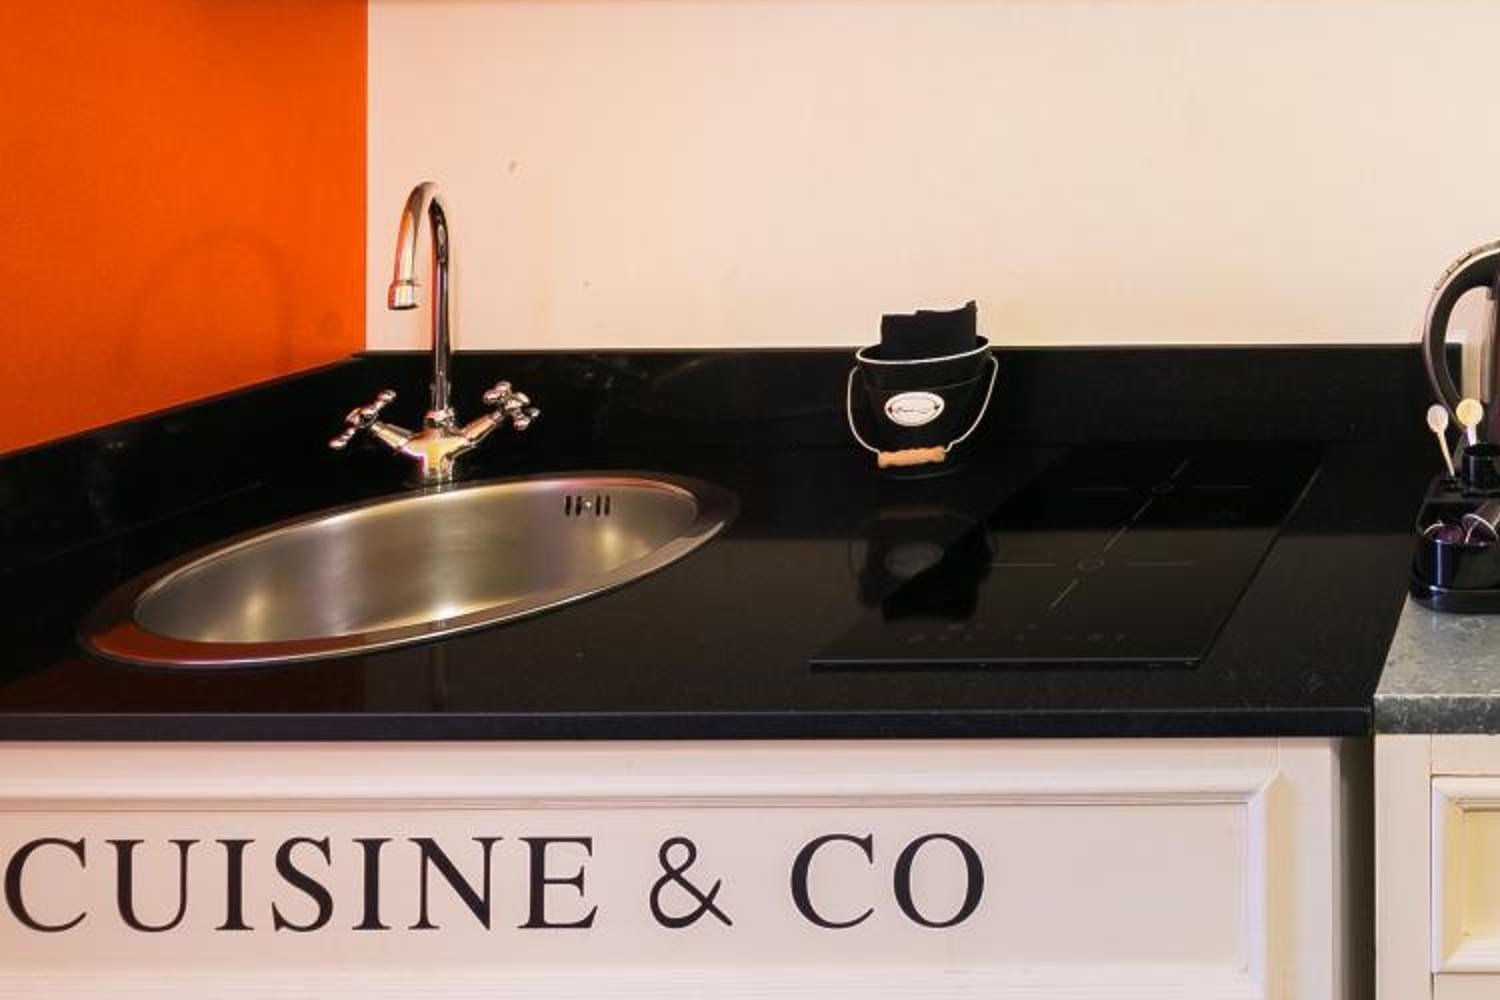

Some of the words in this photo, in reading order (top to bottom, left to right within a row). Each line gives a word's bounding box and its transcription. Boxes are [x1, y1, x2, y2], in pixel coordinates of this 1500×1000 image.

[5, 837, 598, 932] CUISINE
[649, 837, 733, 928] &
[791, 833, 985, 928] CO
